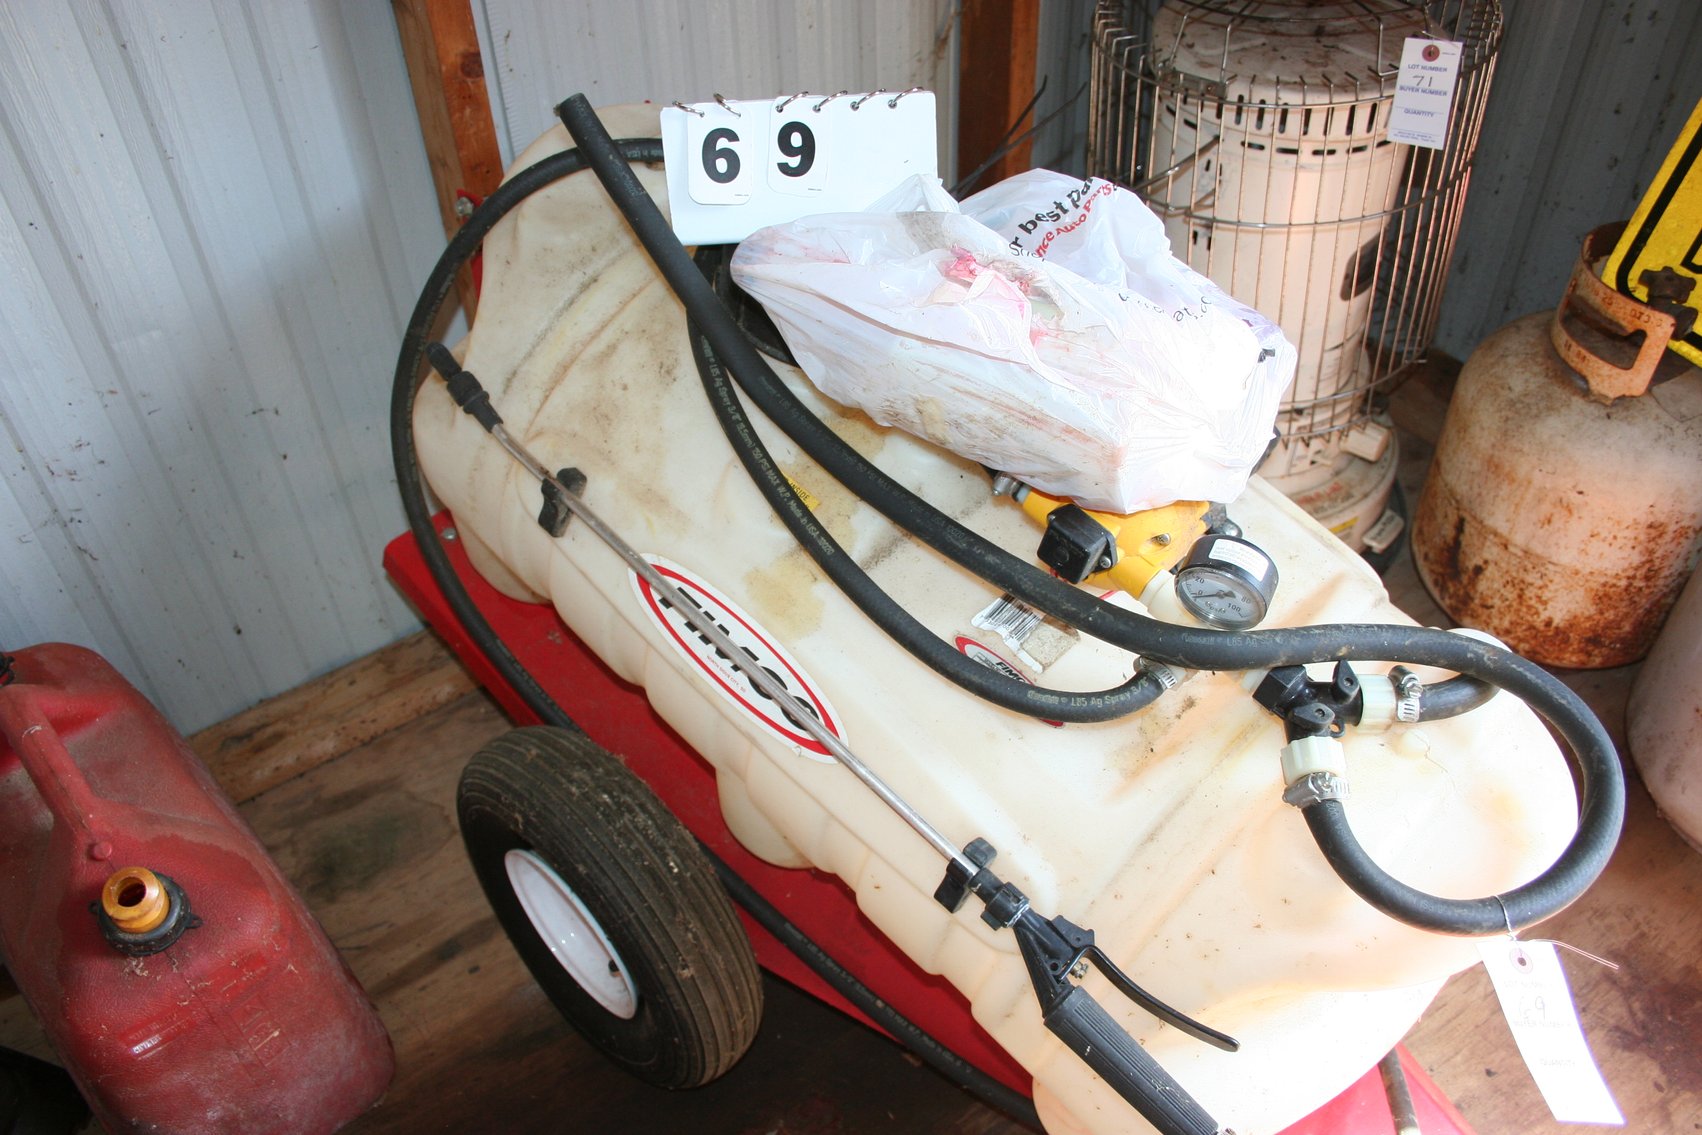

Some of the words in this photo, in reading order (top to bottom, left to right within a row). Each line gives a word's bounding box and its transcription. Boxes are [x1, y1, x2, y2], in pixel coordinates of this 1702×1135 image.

[1412, 75, 1433, 87] 71
[1399, 85, 1420, 93] BUYER
[1421, 88, 1448, 96] NUMBER
[1404, 108, 1434, 117] QUANTITY
[1018, 200, 1069, 235] best
[1056, 213, 1087, 236] Auto
[1103, 690, 1131, 705] Spray
